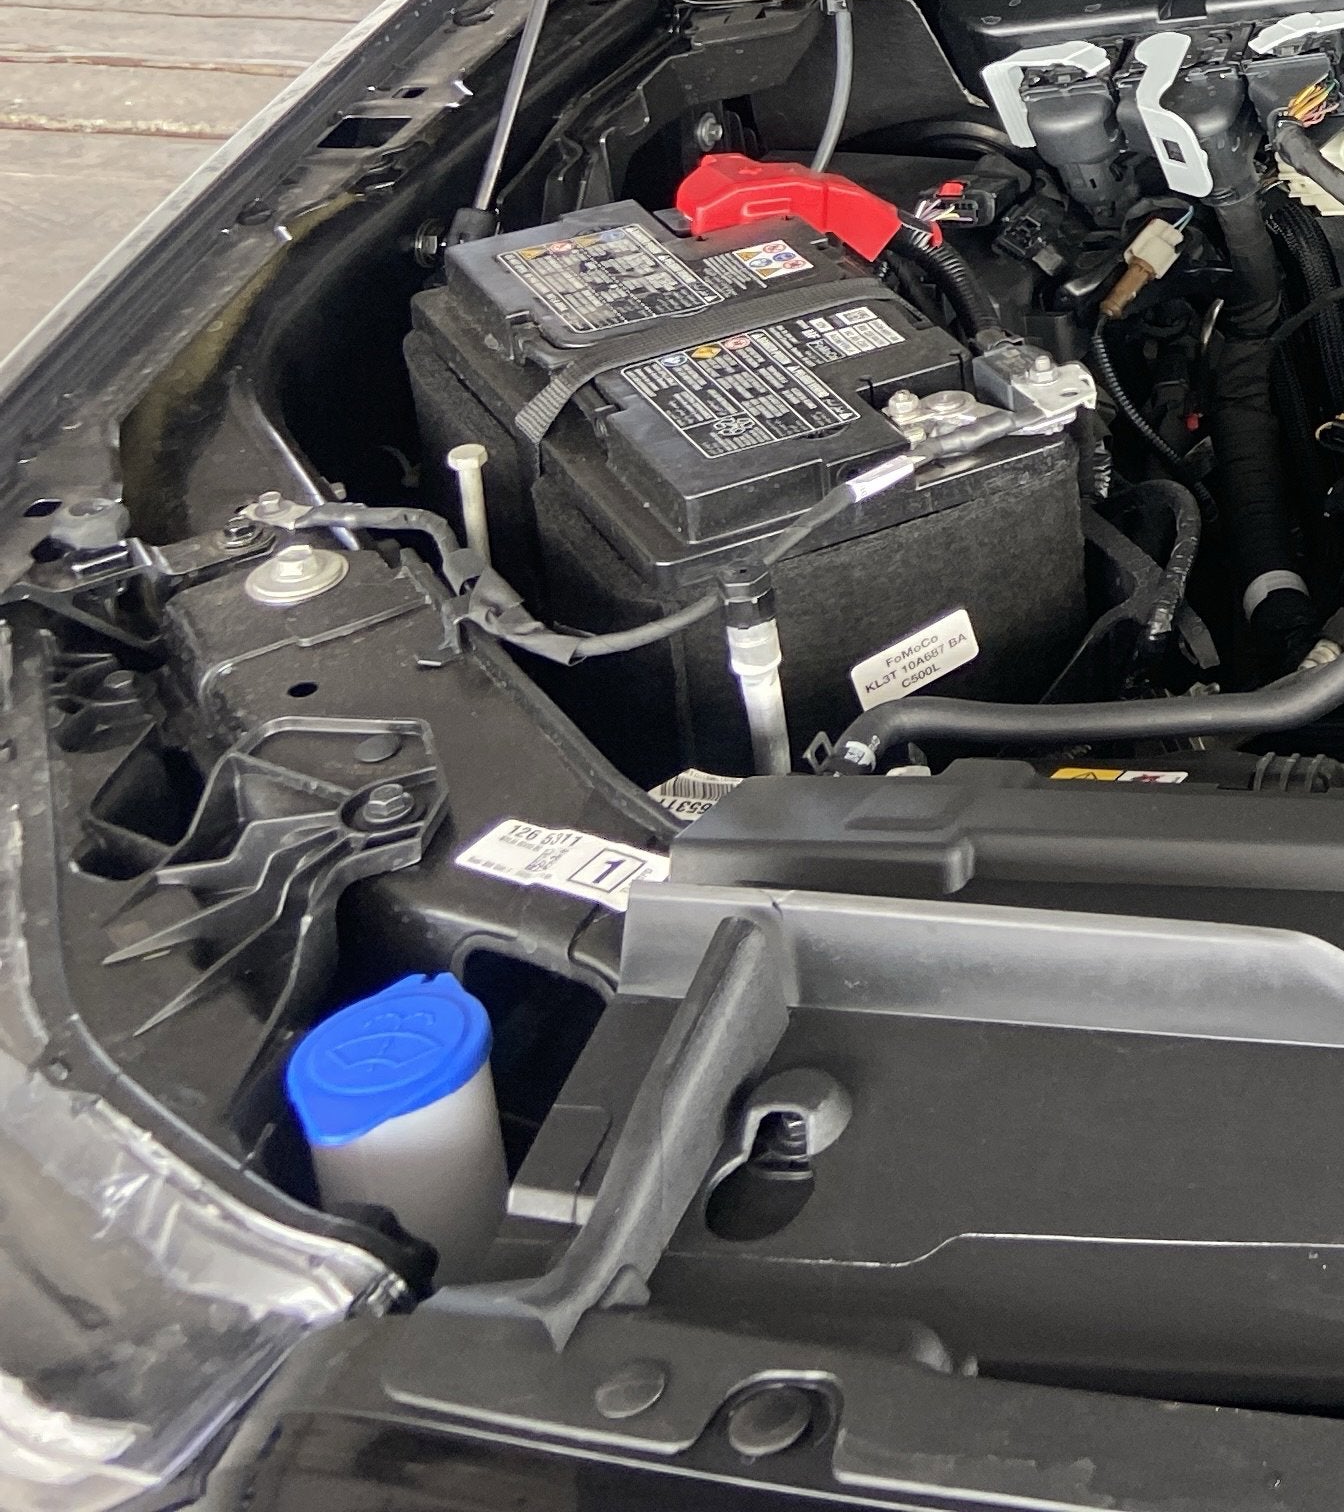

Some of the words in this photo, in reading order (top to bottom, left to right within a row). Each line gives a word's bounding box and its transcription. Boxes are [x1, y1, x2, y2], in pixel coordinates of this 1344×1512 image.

[865, 670, 898, 693] KL3T
[948, 633, 967, 649] BA
[885, 634, 939, 668] FoMoCo
[901, 665, 941, 689] C500L
[508, 824, 542, 841] 126
[591, 858, 624, 884] 1
